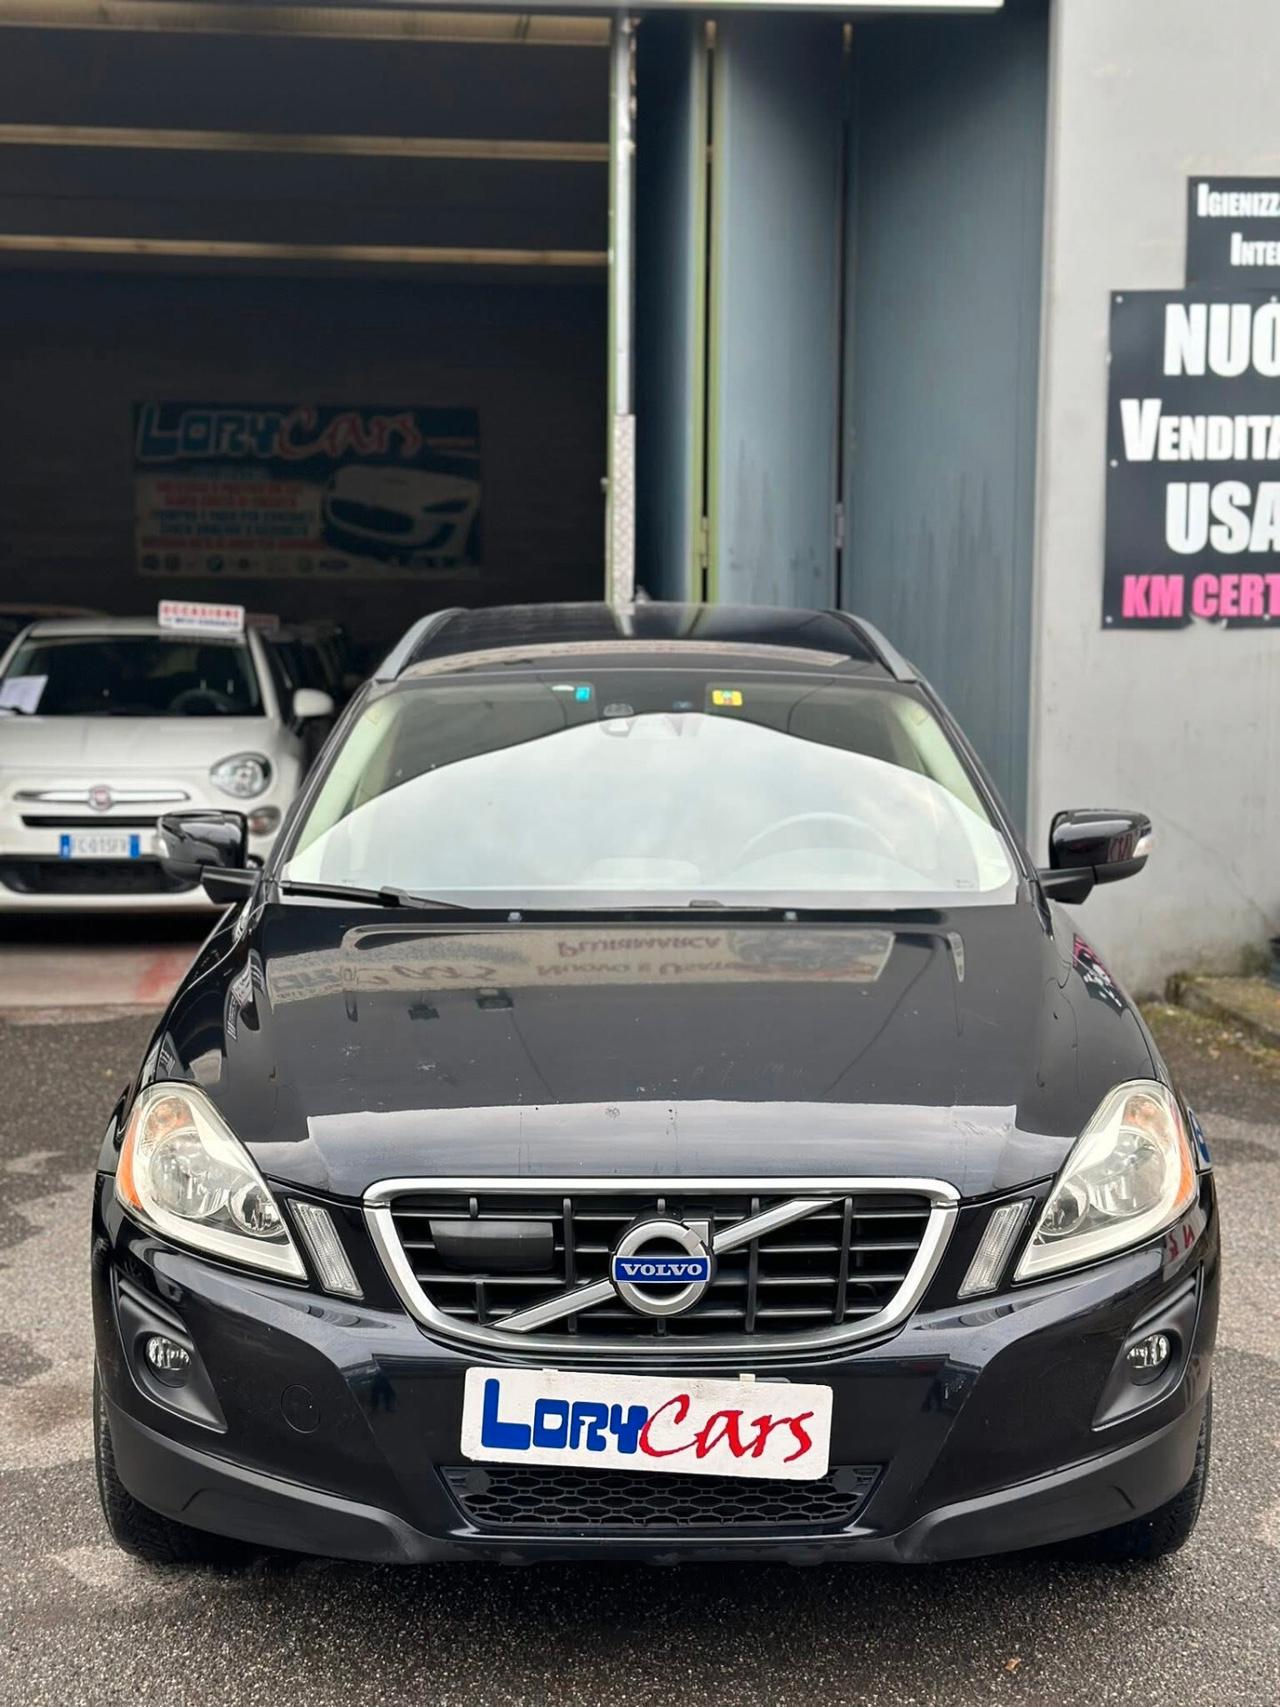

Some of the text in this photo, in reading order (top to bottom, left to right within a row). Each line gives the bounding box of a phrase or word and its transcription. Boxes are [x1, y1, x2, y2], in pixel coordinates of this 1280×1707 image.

[1230, 232, 1280, 266] INTE
[1165, 480, 1280, 554] USA
[1121, 573, 1280, 618] KM CERT
[620, 1262, 703, 1277] VOLVO
